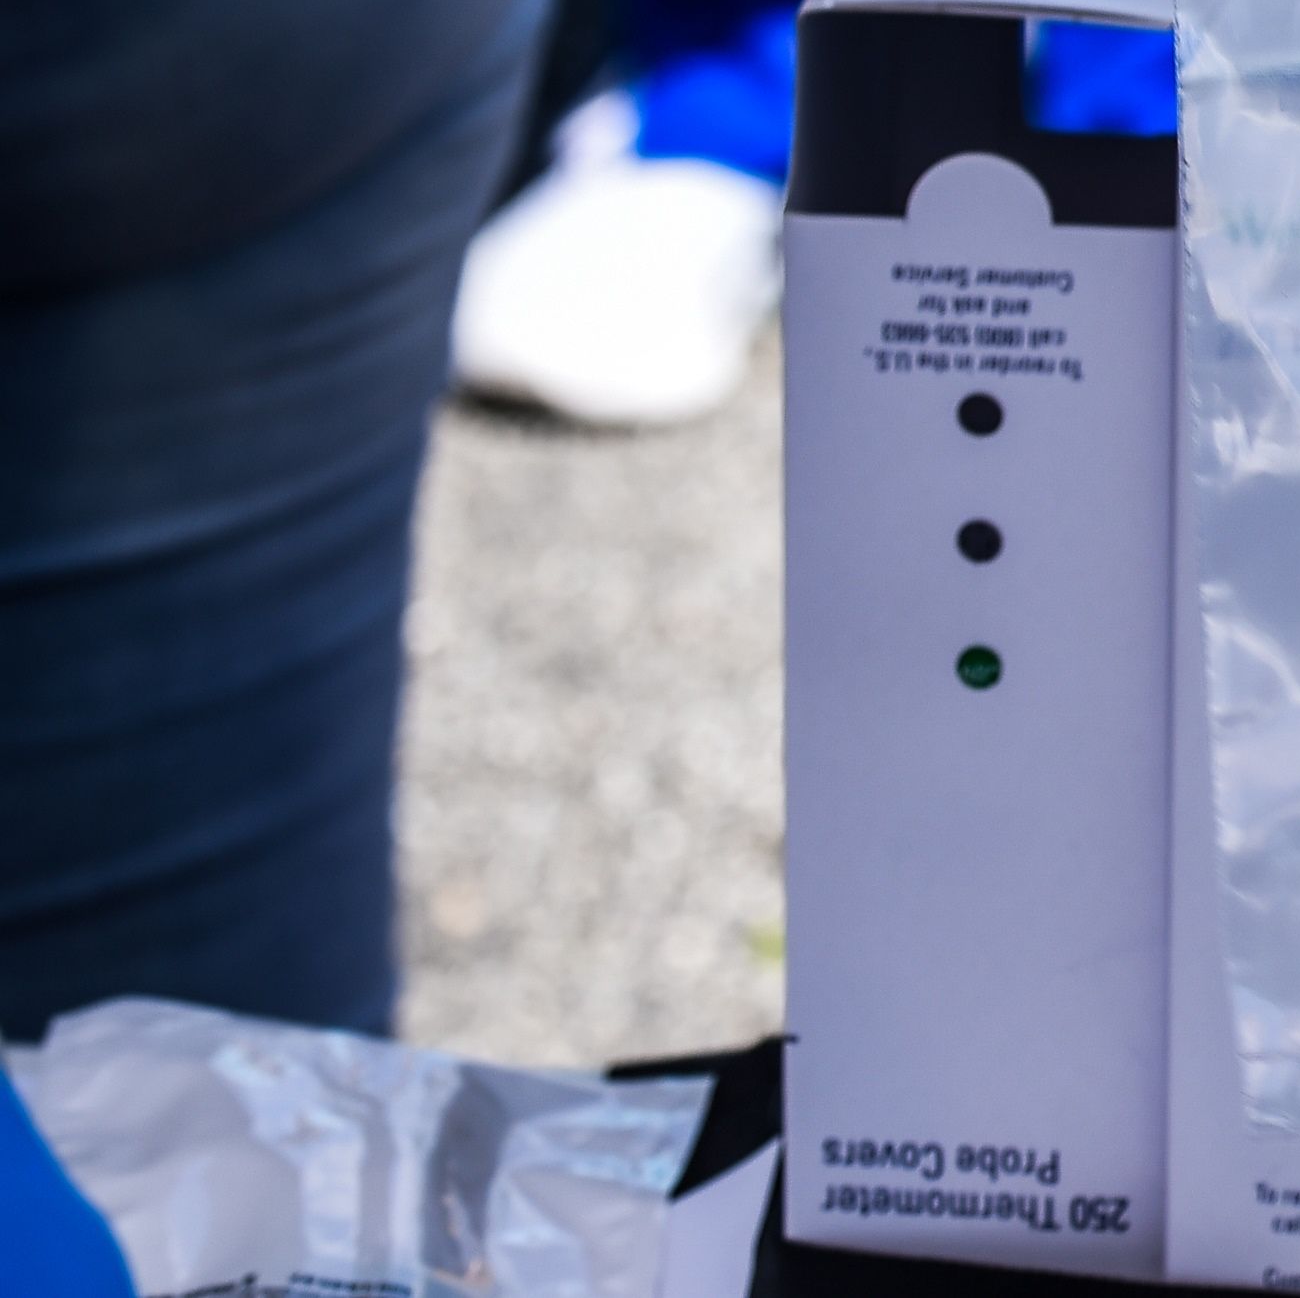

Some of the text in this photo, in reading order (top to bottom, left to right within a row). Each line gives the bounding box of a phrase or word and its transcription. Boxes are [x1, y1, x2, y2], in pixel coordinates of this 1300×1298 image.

[891, 263, 1074, 295] Customer Service
[821, 1137, 1060, 1186] Probe Covers
[821, 1184, 1131, 1232] 250 Thermometer
